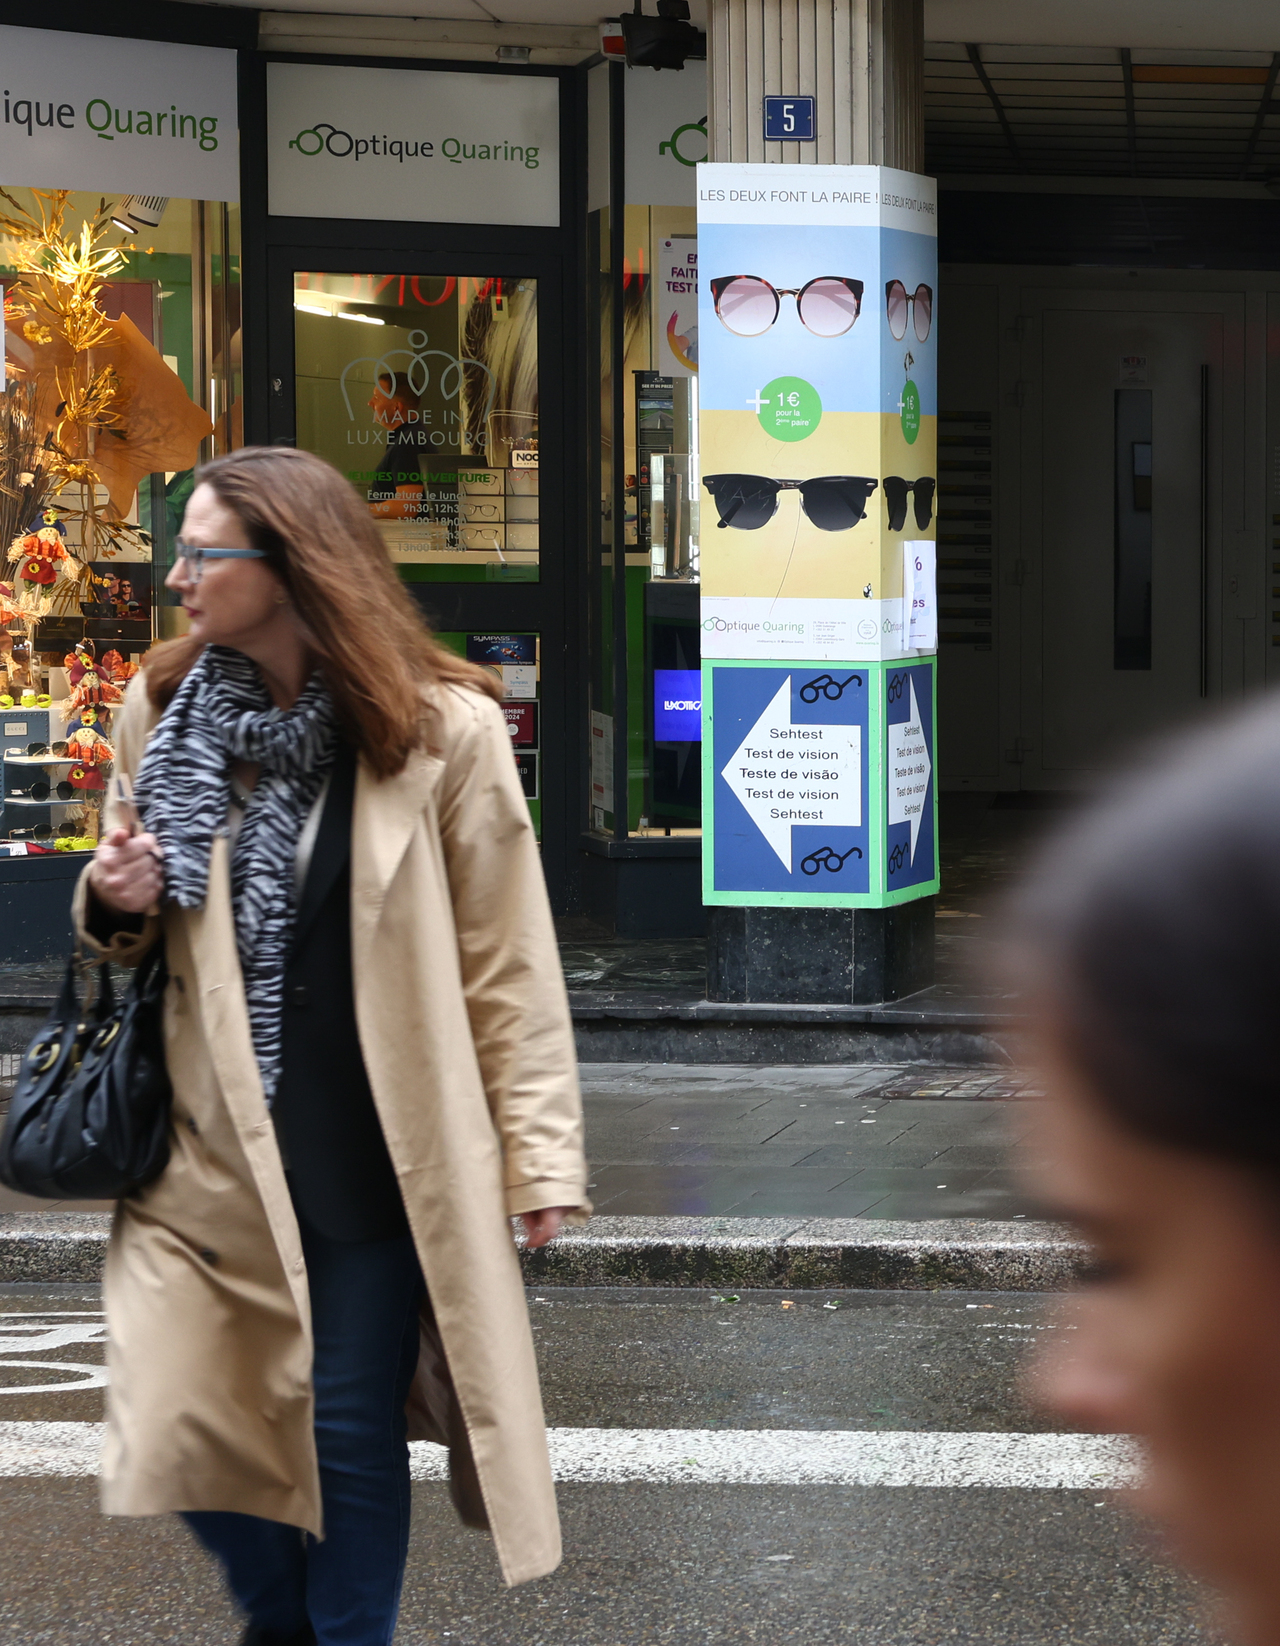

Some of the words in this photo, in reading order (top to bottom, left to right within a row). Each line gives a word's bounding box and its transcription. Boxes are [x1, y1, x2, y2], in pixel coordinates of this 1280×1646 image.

[783, 104, 795, 132] 5
[85, 98, 218, 152] Quaring
[326, 130, 434, 163] Optique
[441, 138, 540, 169] Quaring
[700, 189, 725, 202] LES
[729, 190, 767, 202] DEUX
[770, 190, 808, 202] FONT
[811, 191, 829, 203] LA
[832, 191, 871, 204] PAIRE
[666, 281, 692, 293] TEST
[777, 392, 800, 407] 1€
[372, 409, 432, 425] MADE
[443, 409, 464, 425] IN
[776, 410, 792, 418] pour
[347, 430, 490, 446] LUXEMBOURG
[397, 472, 490, 483] D'OUVERTURE
[367, 490, 423, 500] Fermeture
[426, 490, 437, 499] le
[715, 619, 760, 633] Optique
[763, 620, 804, 634] Quaring
[770, 728, 823, 740] Sehtest
[904, 726, 921, 737] Sehtest
[744, 748, 773, 760] Test
[777, 748, 794, 760] de
[799, 749, 839, 761] vision
[896, 747, 906, 758] Test
[907, 746, 912, 757] de
[912, 744, 925, 755] vision
[739, 768, 776, 780] Teste
[780, 768, 798, 780] de
[802, 769, 839, 780] visão
[895, 767, 907, 778] Teste
[907, 766, 913, 777] de
[914, 763, 925, 775] visão
[745, 788, 773, 800] Test
[777, 788, 795, 800] de
[799, 789, 839, 800] vision
[896, 787, 906, 798] Test
[907, 786, 912, 796] de
[912, 784, 925, 794] vision
[770, 808, 824, 820] Sehtest
[904, 803, 921, 816] Sehtest
